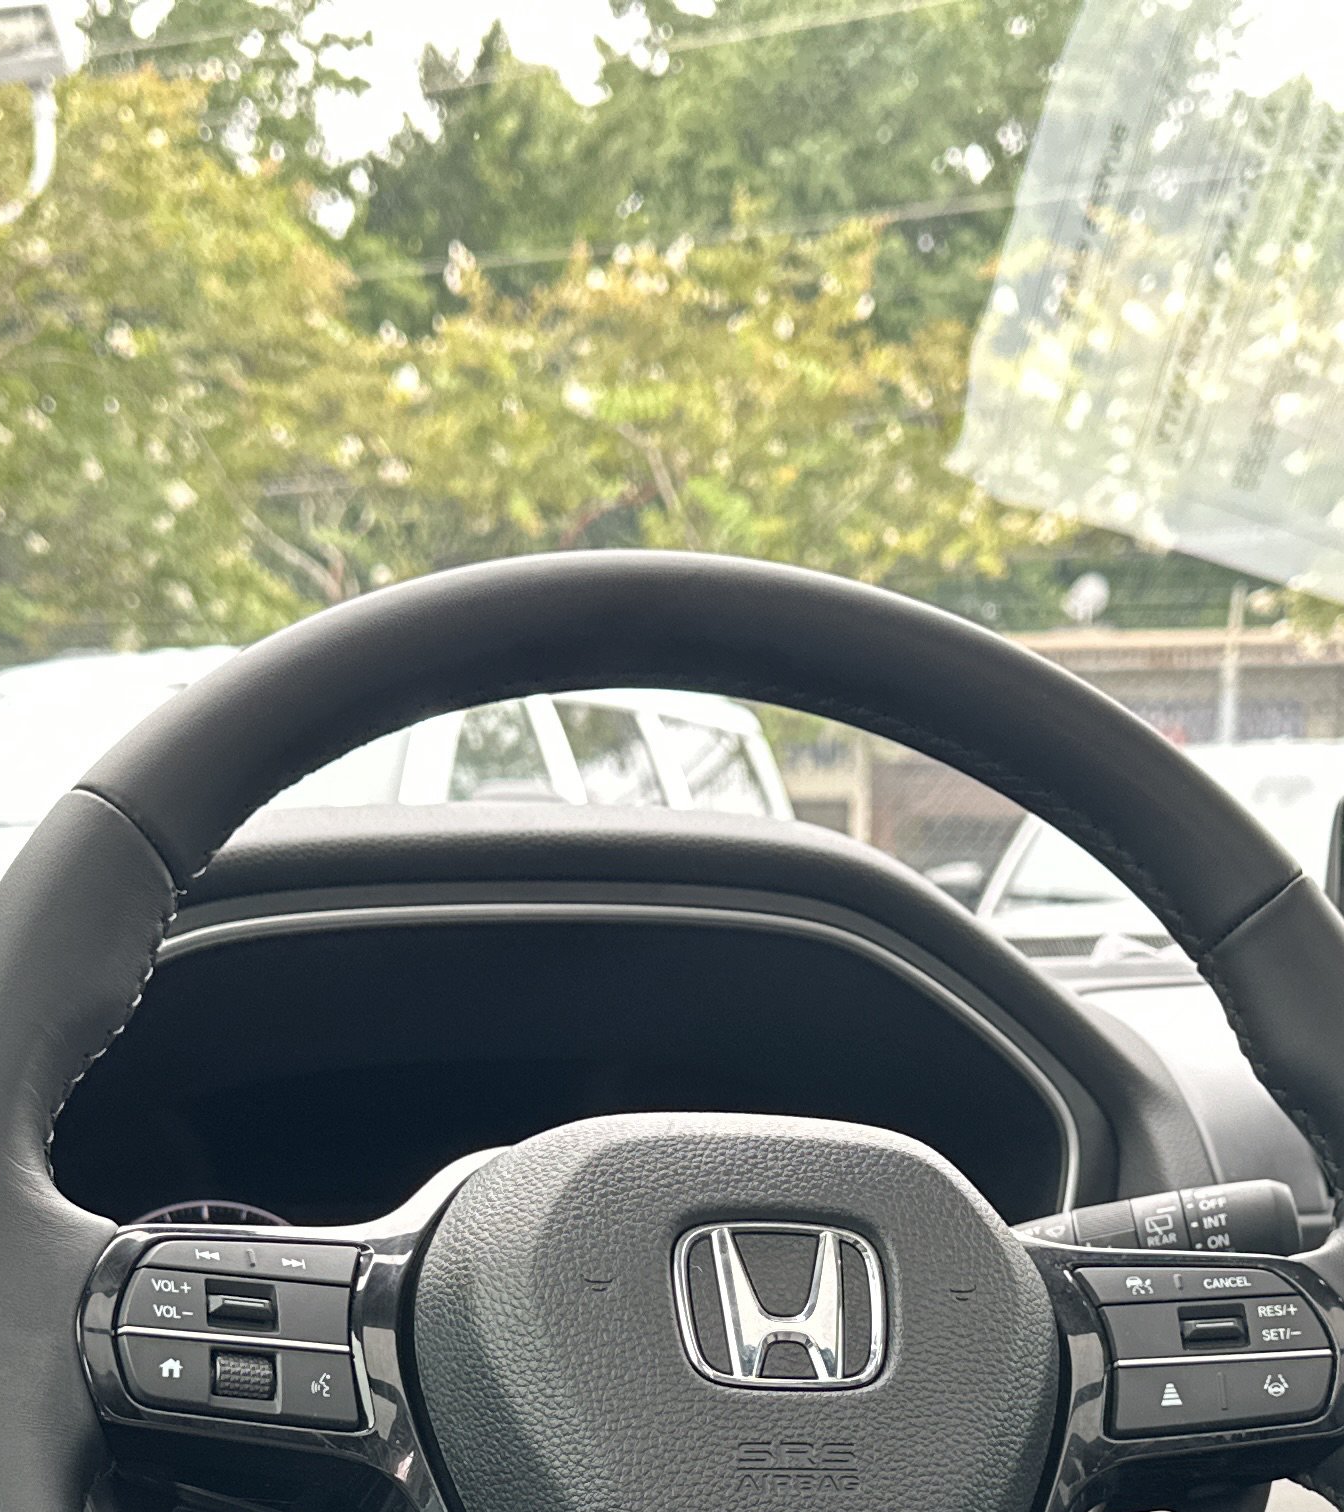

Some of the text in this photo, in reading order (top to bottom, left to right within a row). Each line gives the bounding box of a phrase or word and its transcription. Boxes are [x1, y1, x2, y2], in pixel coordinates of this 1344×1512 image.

[1198, 1196, 1227, 1211] OFF
[1202, 1213, 1228, 1229] INT
[1146, 1232, 1177, 1247] REAR
[1207, 1232, 1230, 1249] ON
[1203, 1275, 1252, 1289] CANCEL
[1257, 1304, 1299, 1318] RES/+
